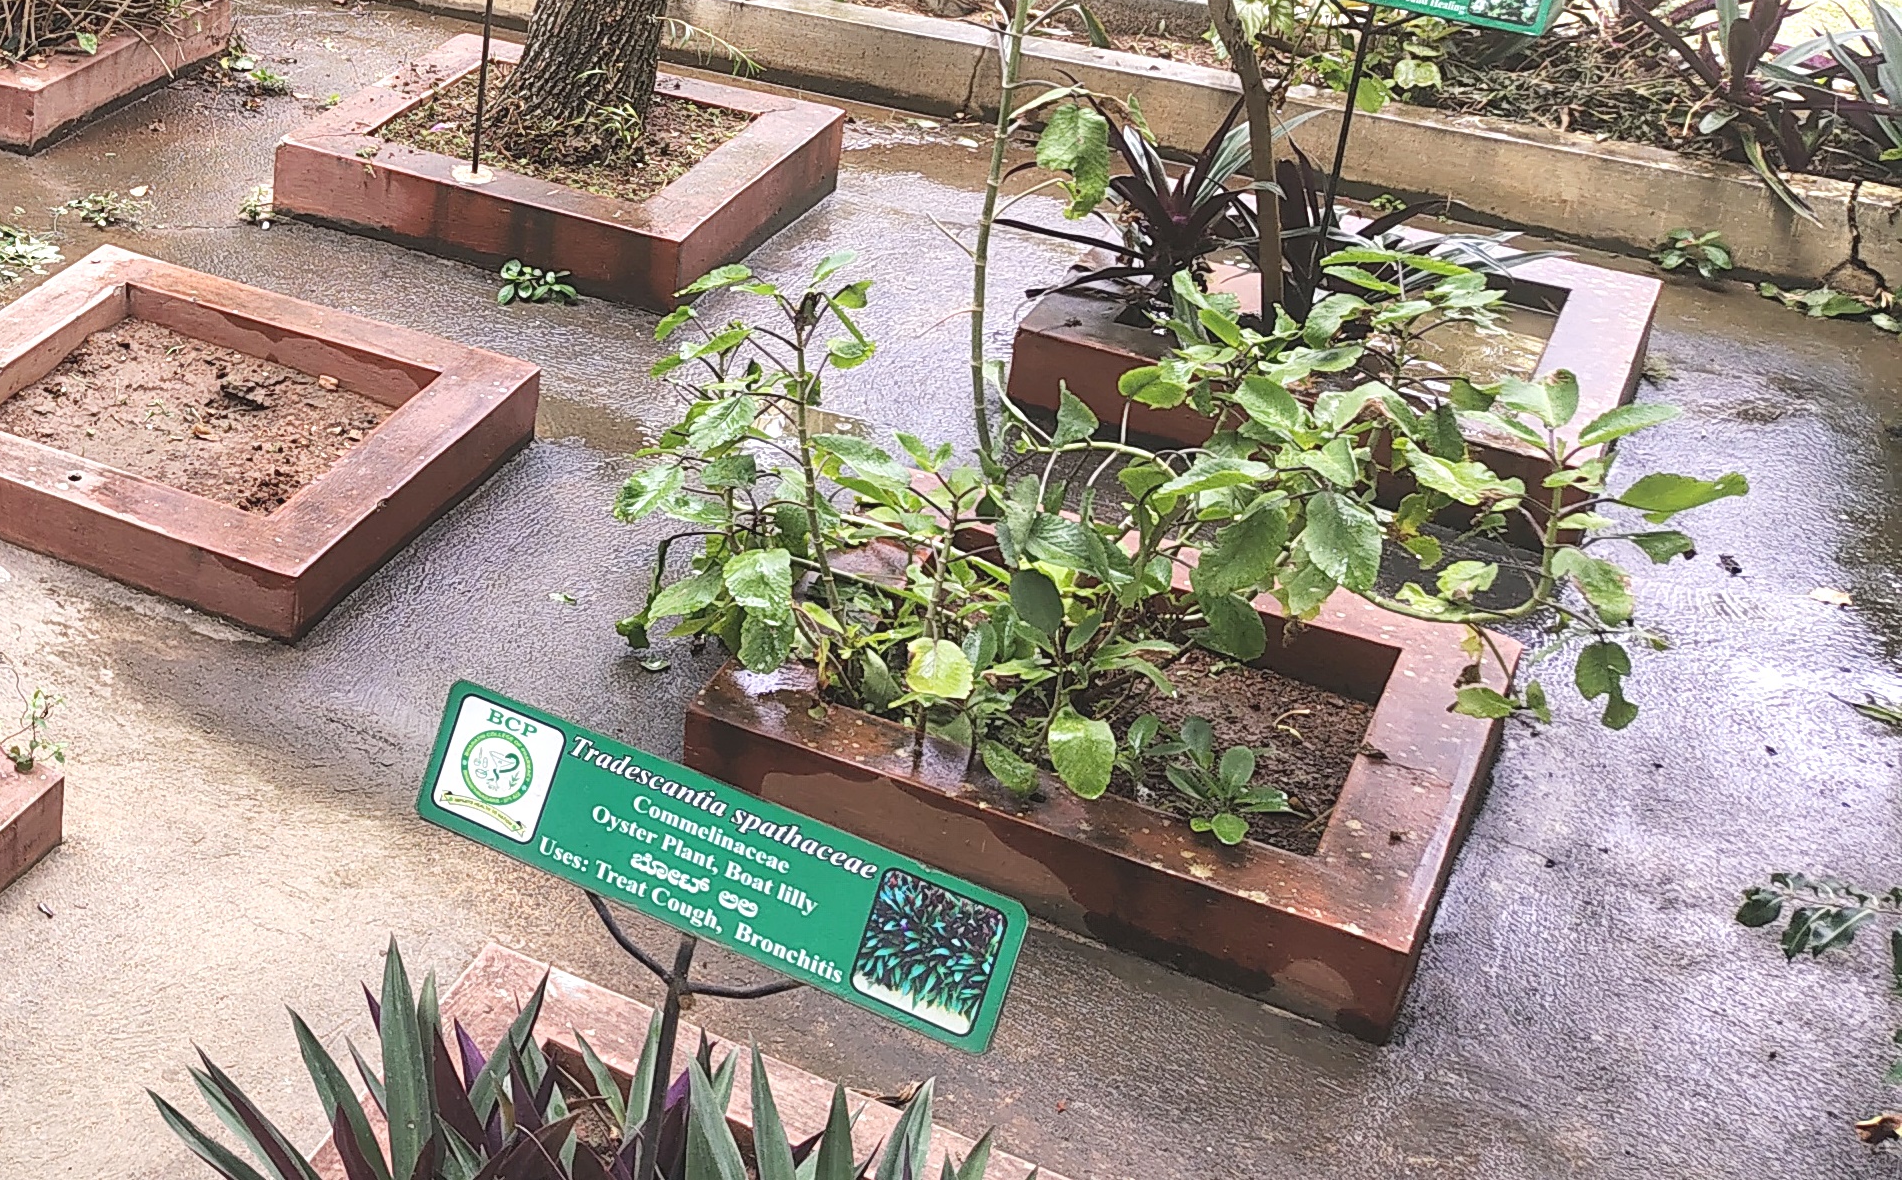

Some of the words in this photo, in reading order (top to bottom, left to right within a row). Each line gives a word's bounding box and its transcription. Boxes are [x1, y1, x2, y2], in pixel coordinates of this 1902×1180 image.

[486, 708, 538, 737] BCP
[571, 736, 727, 816] Tradescantia
[730, 809, 878, 878] spathaceae
[592, 805, 658, 844] Oyster
[661, 833, 718, 875] Plant,
[724, 860, 774, 895] Boat
[776, 883, 818, 916] lilly
[633, 795, 790, 873] Commelinaceae
[539, 835, 589, 872] Uses:
[596, 859, 648, 897] Treat
[651, 887, 722, 934] Cough,
[734, 922, 842, 983] Bronchitis
